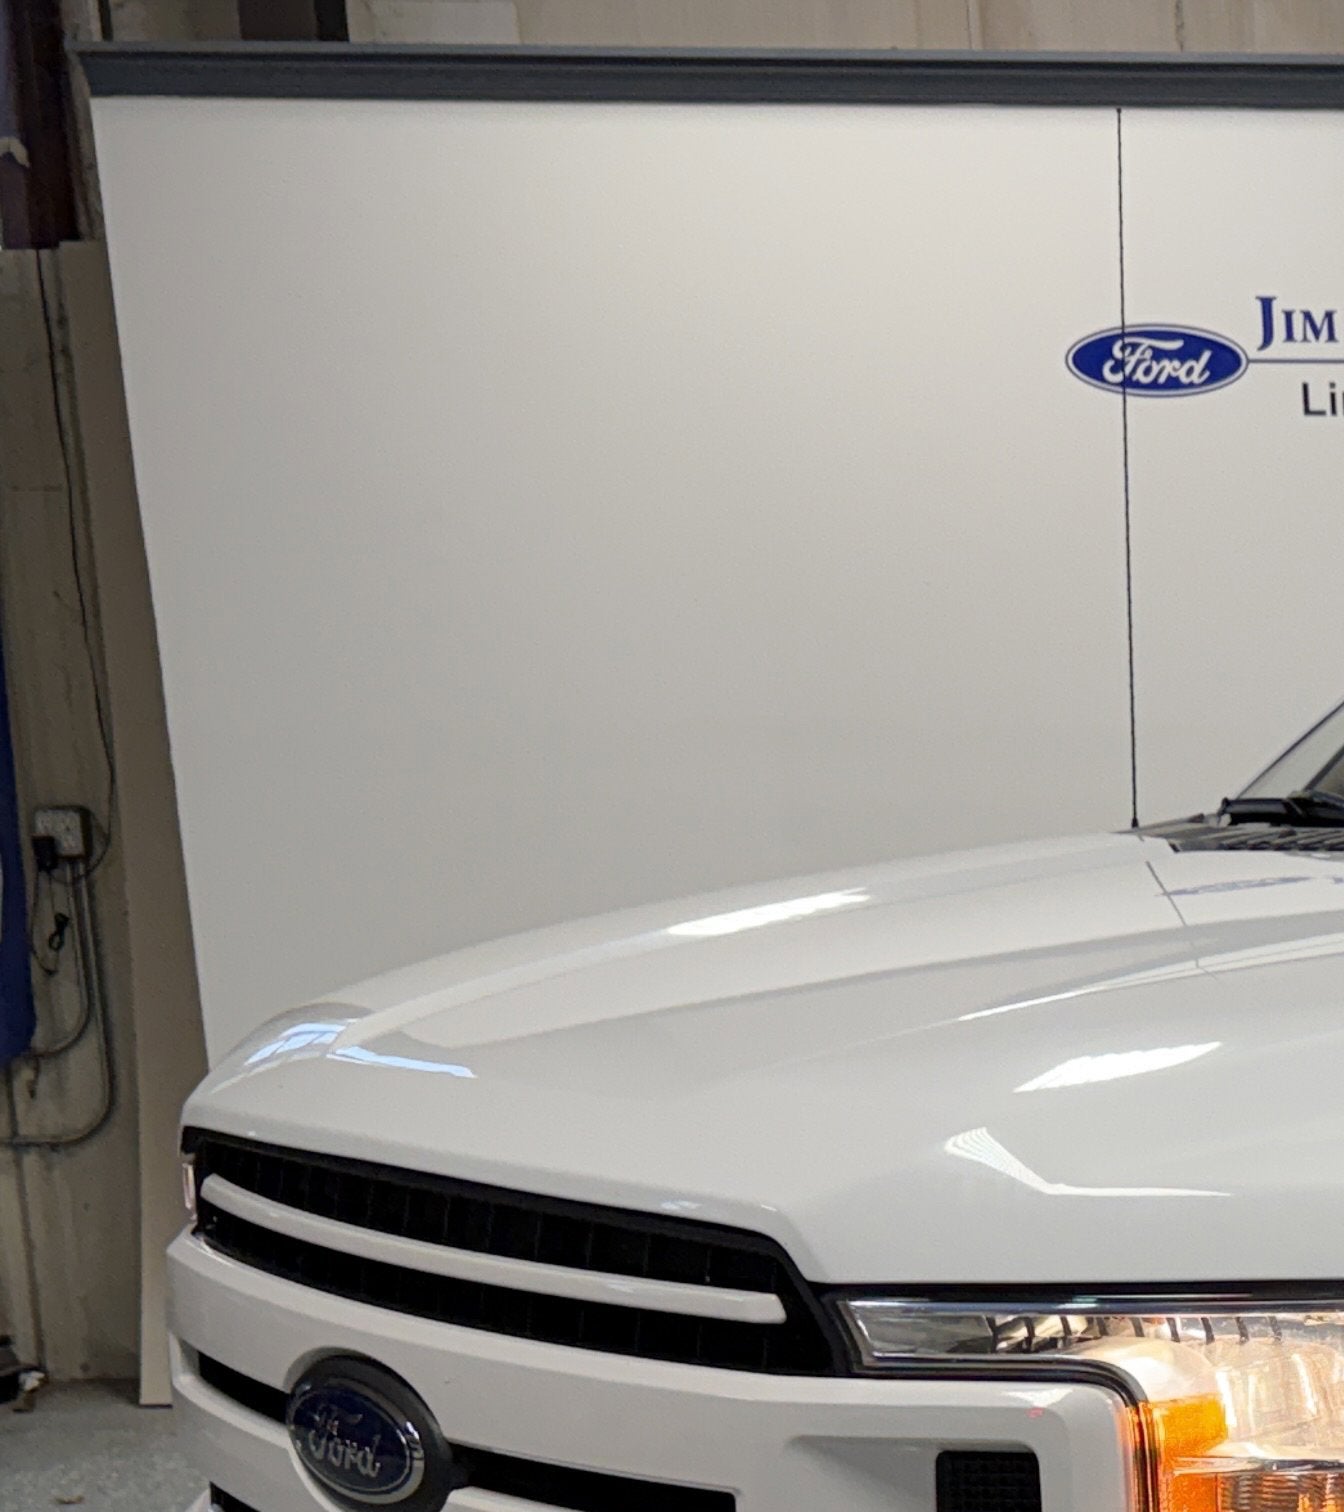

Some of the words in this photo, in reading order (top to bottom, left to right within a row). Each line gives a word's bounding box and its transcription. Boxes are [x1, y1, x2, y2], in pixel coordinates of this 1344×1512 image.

[1255, 296, 1339, 351] JIM
[1102, 336, 1212, 384] Ford
[307, 1403, 382, 1479] Ford
